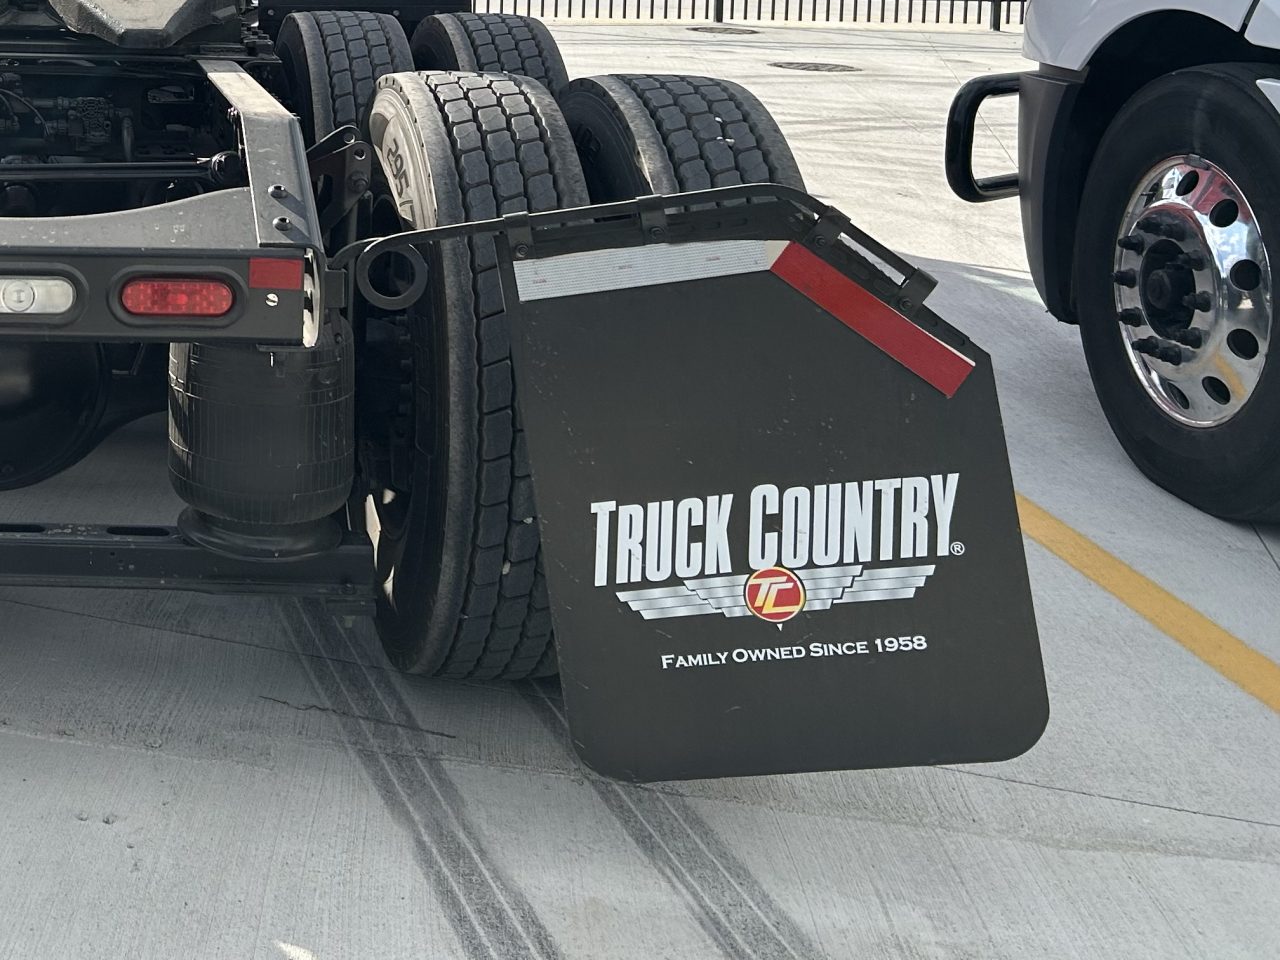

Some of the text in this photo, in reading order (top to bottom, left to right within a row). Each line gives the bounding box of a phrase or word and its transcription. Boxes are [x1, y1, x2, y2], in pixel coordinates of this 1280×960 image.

[590, 493, 734, 587] TRUCK
[661, 636, 928, 669] FAMILY OWNED SINCE 1958
